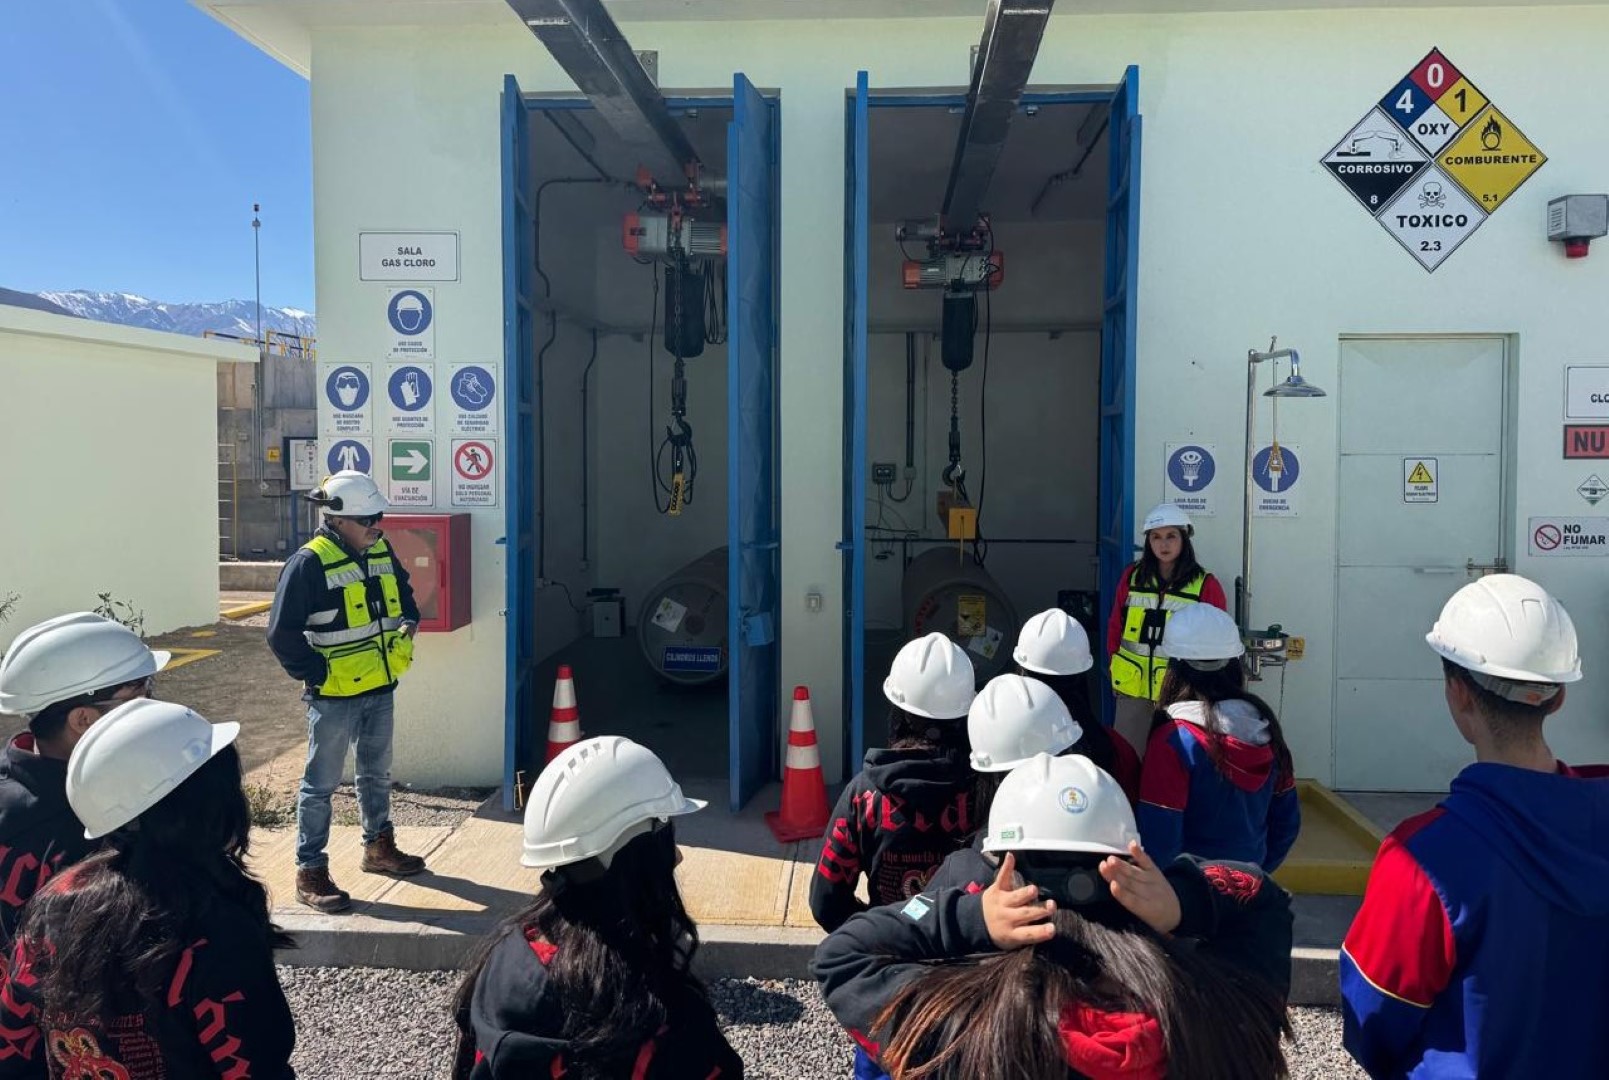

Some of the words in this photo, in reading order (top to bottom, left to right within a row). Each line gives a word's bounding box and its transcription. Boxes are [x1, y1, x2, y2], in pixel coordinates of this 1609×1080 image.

[1427, 63, 1444, 88] 0
[1396, 89, 1414, 113] 4
[1454, 88, 1466, 112] 1
[1418, 123, 1450, 136] OXY
[1445, 154, 1537, 165] COMBURENTE
[1338, 164, 1414, 174] CORROSIVO
[1370, 194, 1378, 204] 8
[1482, 194, 1498, 203] 5.1
[1396, 214, 1468, 228] TOXICO
[397, 246, 423, 256] SALA
[1420, 241, 1441, 251] 2.3
[381, 258, 401, 267] GAS
[404, 258, 436, 267] CLORO
[1574, 430, 1606, 453] NU
[1563, 523, 1581, 534] NO
[1563, 534, 1606, 545] FUMAR
